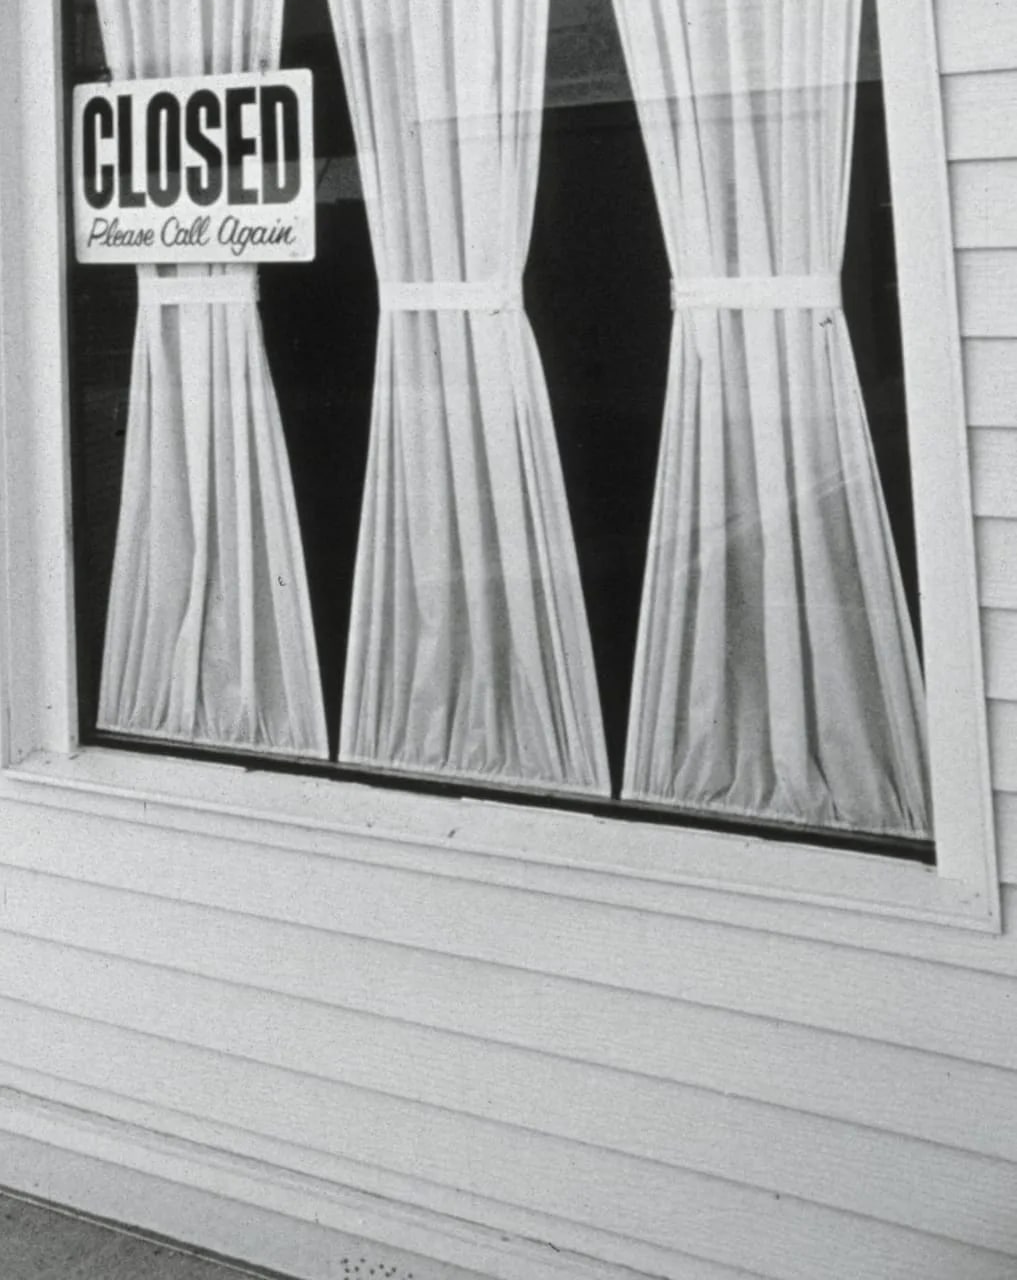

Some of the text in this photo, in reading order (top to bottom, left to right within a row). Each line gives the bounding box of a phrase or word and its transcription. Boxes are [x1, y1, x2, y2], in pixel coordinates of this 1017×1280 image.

[83, 84, 301, 209] CLOSED
[87, 215, 297, 256] Please Call Again
